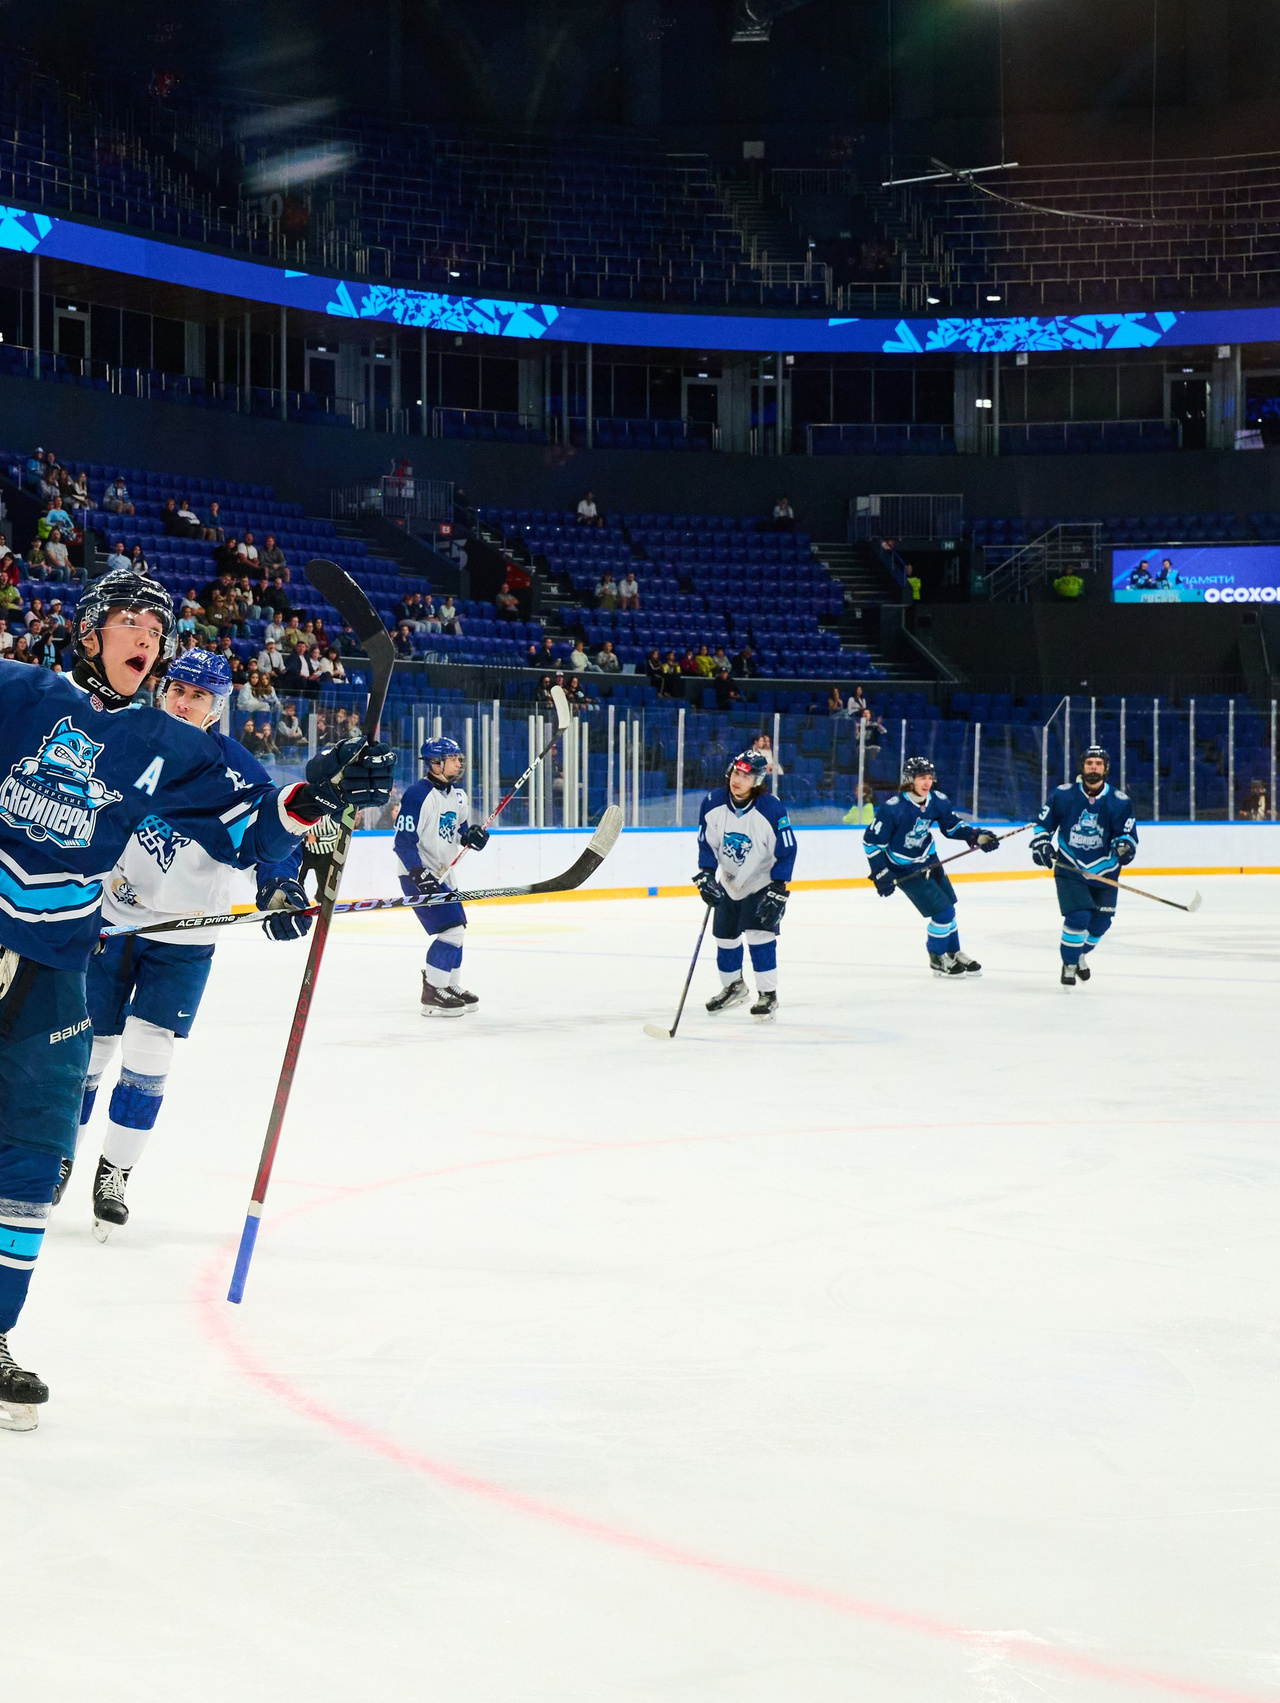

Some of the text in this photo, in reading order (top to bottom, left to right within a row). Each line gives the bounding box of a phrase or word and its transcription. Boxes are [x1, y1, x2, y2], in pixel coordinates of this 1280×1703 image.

[1204, 587, 1280, 604] ОСОХО
[133, 756, 165, 796] A
[26, 779, 81, 805] СИБИРСКИЕ
[396, 815, 415, 832] 88
[782, 830, 793, 847] 11
[334, 893, 449, 912] SOYUZ
[176, 918, 202, 928] ACE
[204, 915, 235, 926] prime
